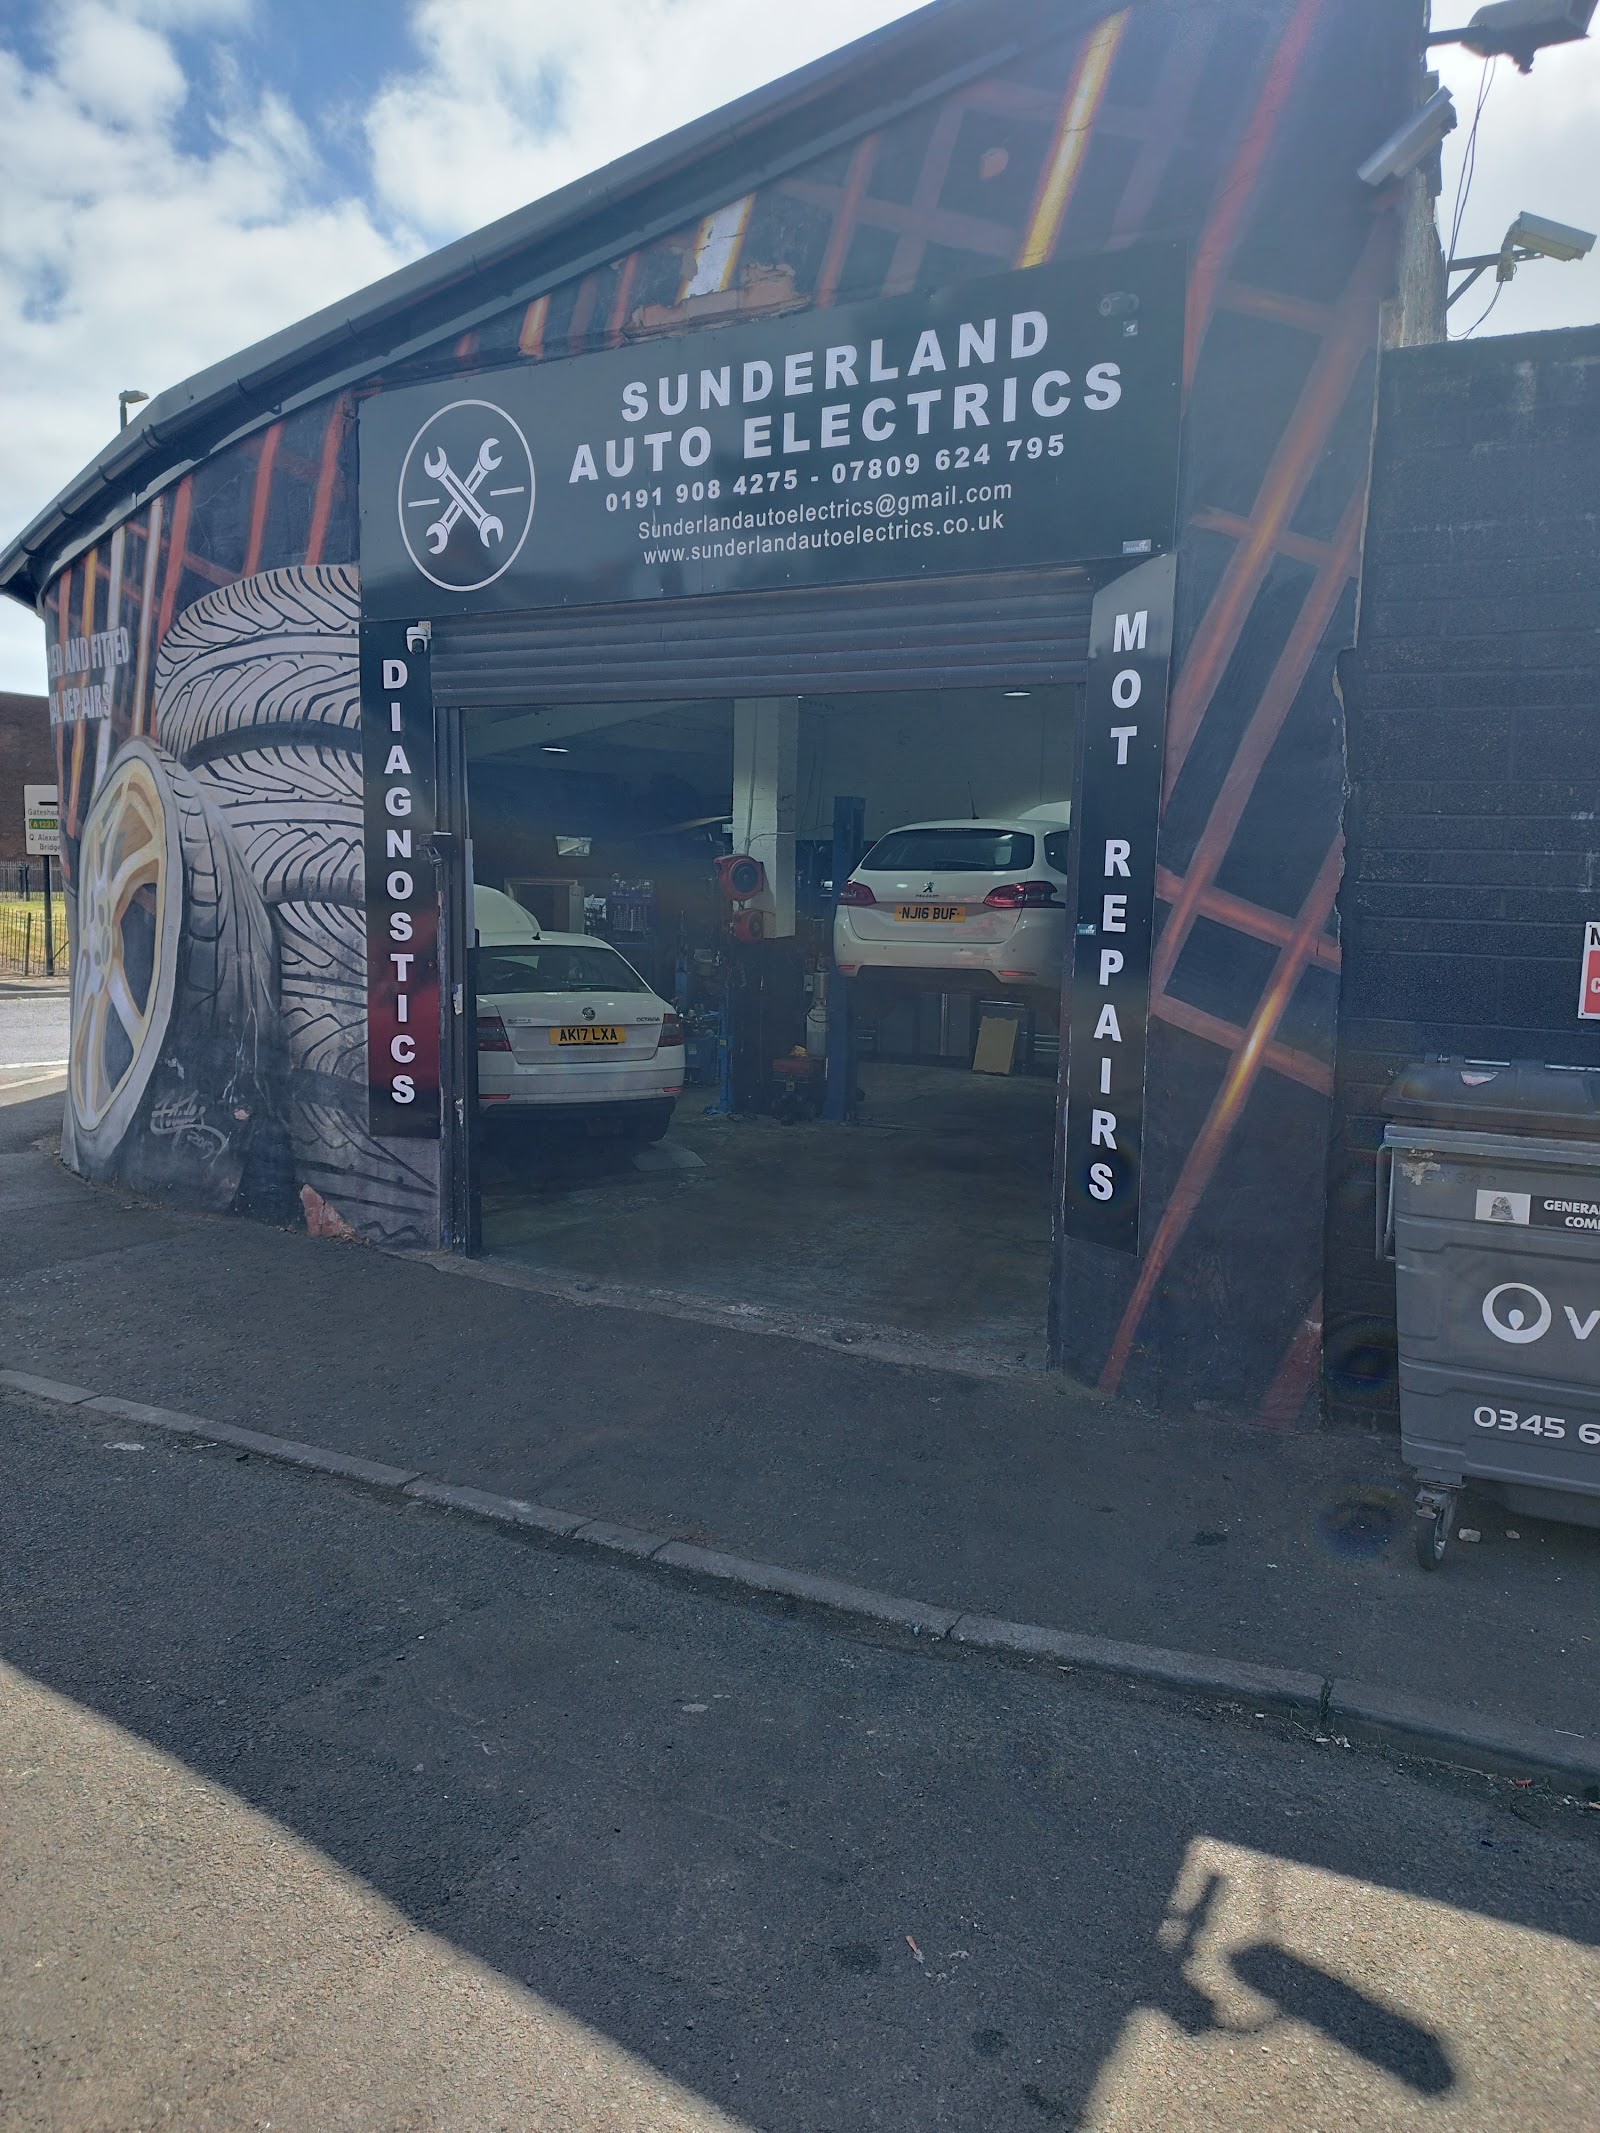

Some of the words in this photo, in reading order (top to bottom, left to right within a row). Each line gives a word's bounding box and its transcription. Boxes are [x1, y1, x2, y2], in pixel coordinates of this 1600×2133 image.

[622, 310, 1048, 421] SUNDERLAND
[568, 427, 712, 484] AUTO
[744, 362, 1122, 459] ELECTRICS
[605, 487, 662, 512] 0191
[676, 480, 721, 504] 908
[733, 469, 798, 496] 4275
[832, 454, 920, 484] 07809
[936, 444, 991, 470] 624
[1007, 434, 1064, 462] 795
[638, 483, 1012, 540] Sunderlandautoelectrics@gmail.com
[643, 509, 1004, 564] www.sunderlandautoelectrics.co.uk
[65, 636, 90, 673] AND
[90, 626, 130, 670] FITTED
[62, 683, 112, 723] REPAIRS
[1109, 610, 1148, 765] MOT
[382, 659, 416, 1104] DIAGNOSTICS
[902, 907, 930, 920] NJ16
[932, 907, 958, 920] BUF
[559, 1028, 588, 1042] AK17
[592, 1027, 618, 1041] LXA
[1088, 839, 1132, 1201] REPAIRS
[1543, 1199, 1600, 1216] GENERA
[1565, 1216, 1600, 1230] COM
[1473, 1406, 1566, 1439] 0345
[1578, 1423, 1600, 1445] 6
